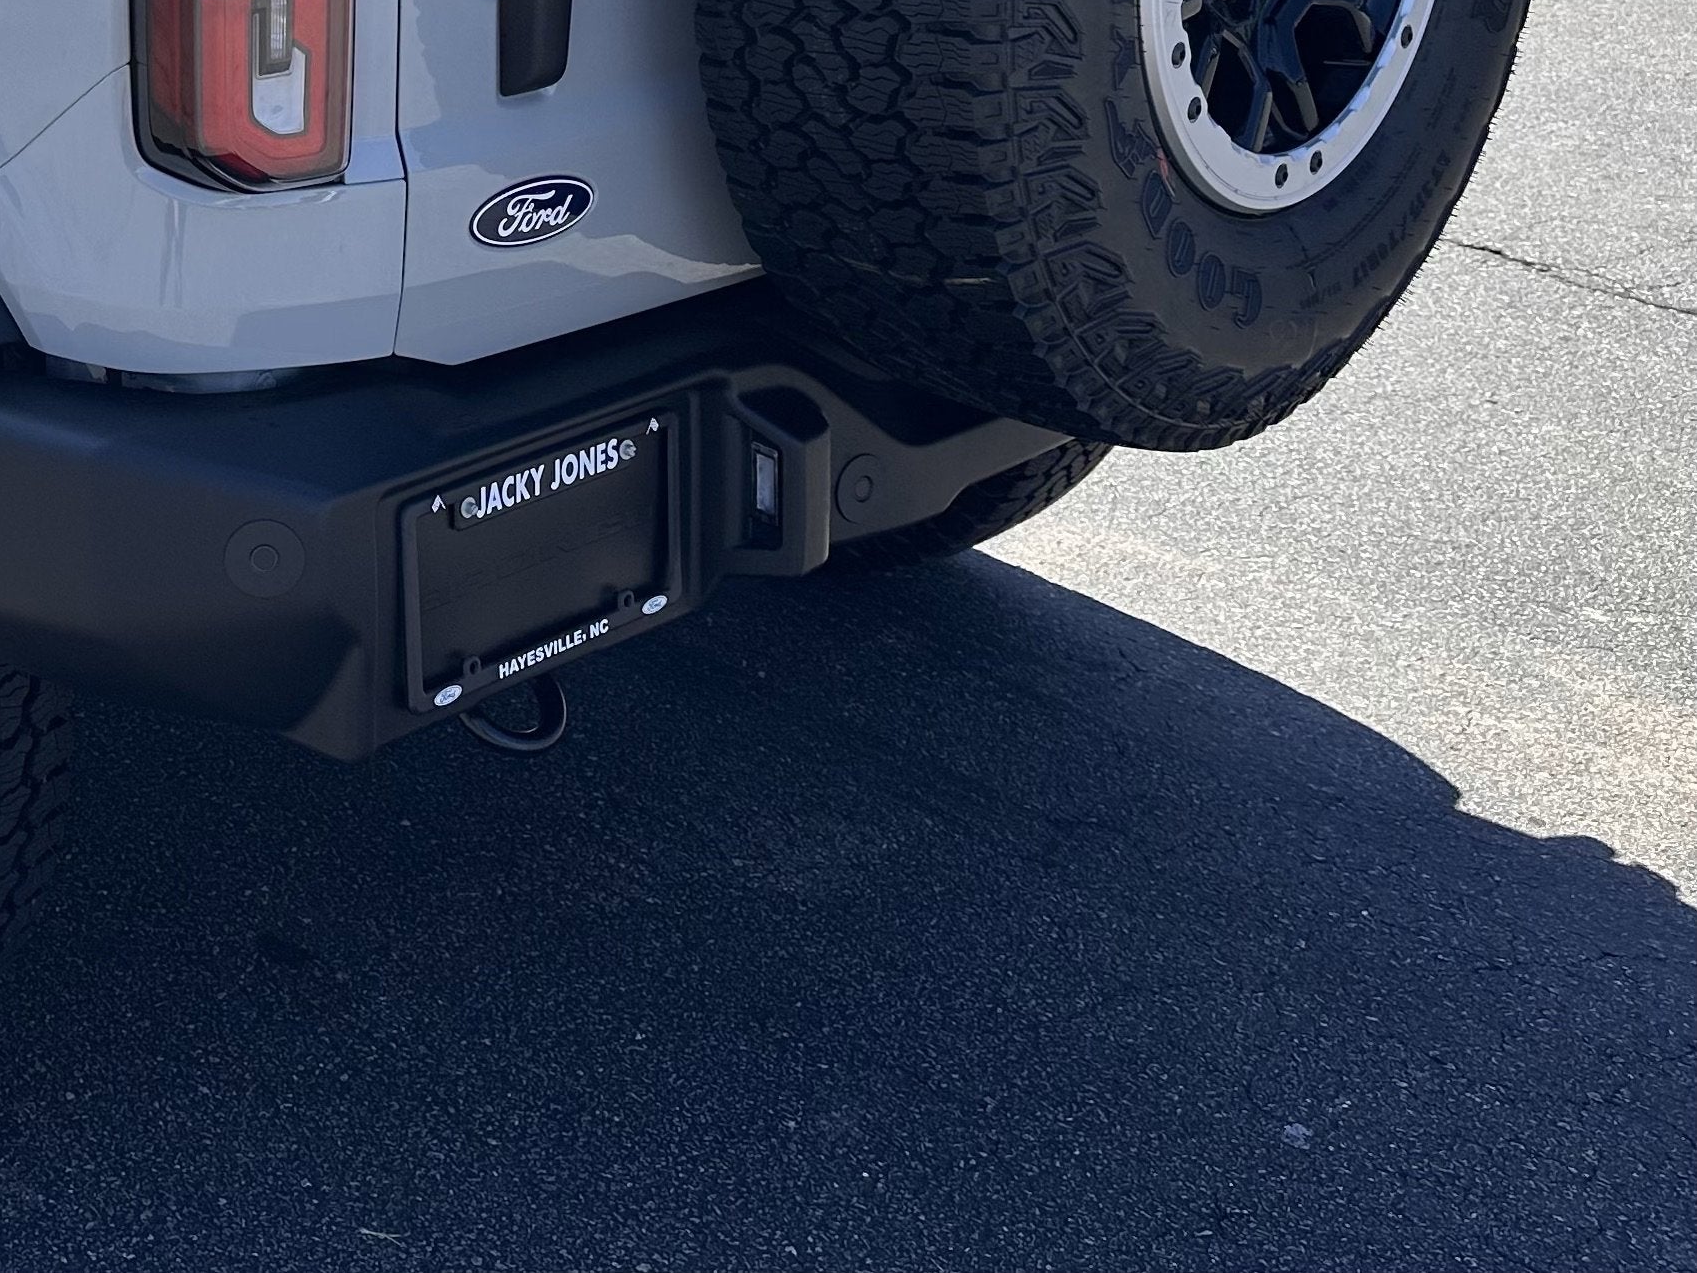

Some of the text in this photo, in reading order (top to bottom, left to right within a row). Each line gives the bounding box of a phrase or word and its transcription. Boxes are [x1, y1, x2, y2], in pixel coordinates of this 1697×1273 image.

[497, 189, 574, 238] Ford
[476, 438, 619, 519] JACKY JONES
[498, 618, 609, 679] HAYESVILLE, NC
